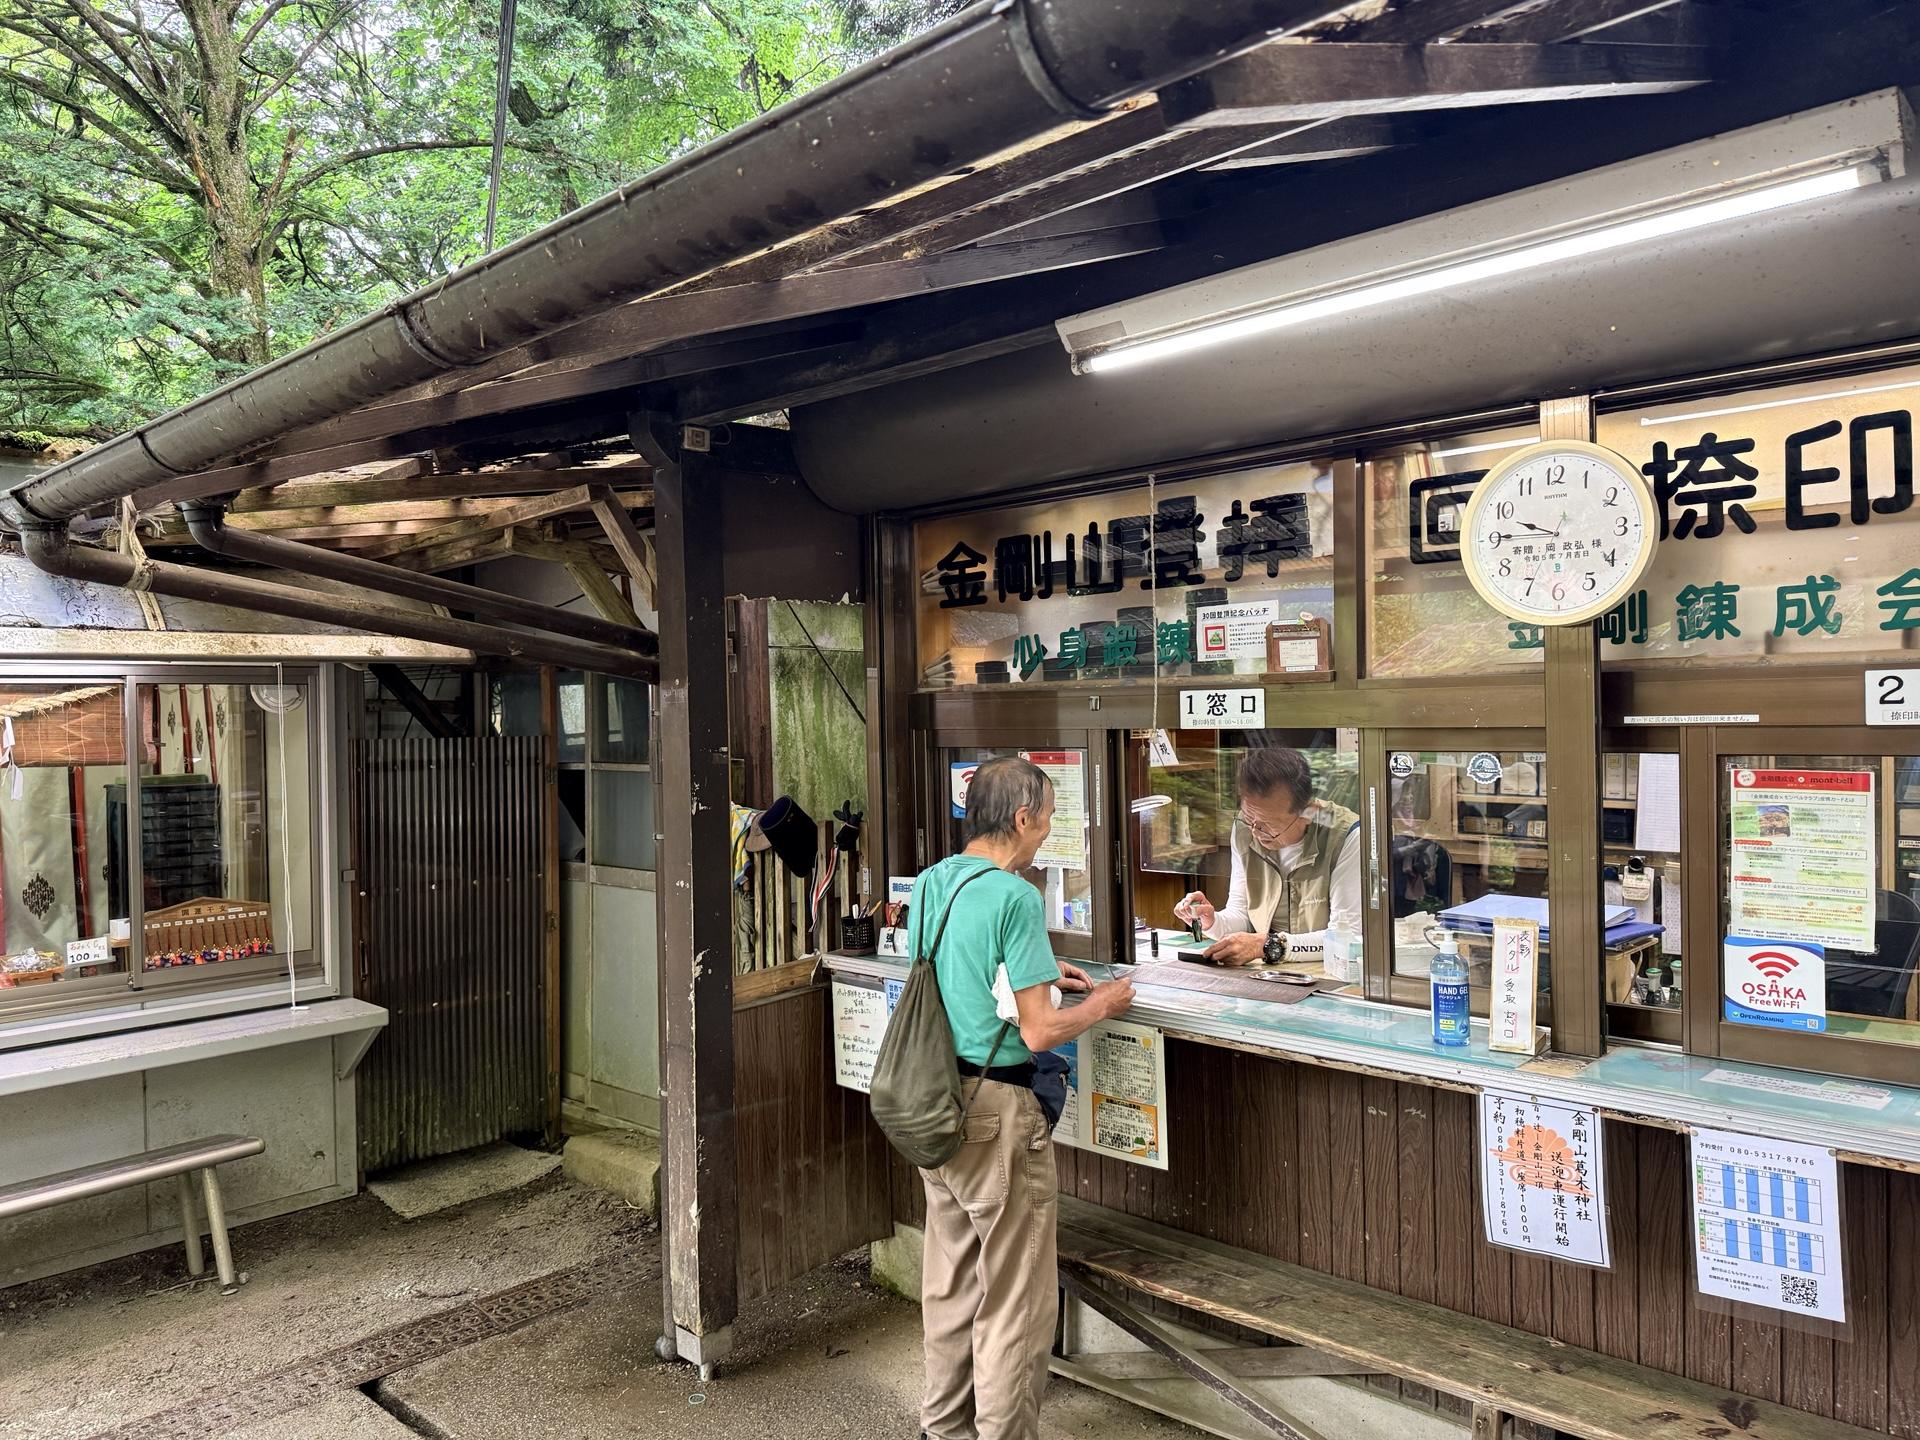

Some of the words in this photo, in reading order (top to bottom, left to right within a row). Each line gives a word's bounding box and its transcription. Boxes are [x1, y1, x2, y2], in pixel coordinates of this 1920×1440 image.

[1545, 464, 1566, 486] 12
[1582, 470, 1589, 489] 1
[1518, 477, 1533, 497] 11
[1544, 492, 1568, 500] RHYTHM
[1602, 487, 1618, 508] 2
[1496, 500, 1514, 520] 10
[1613, 516, 1628, 536] 3
[1489, 531, 1502, 549] 9
[1562, 540, 1585, 550] 政弘
[1591, 538, 1602, 549] 様
[1498, 558, 1512, 577] 8
[1603, 548, 1616, 567] 4
[1523, 577, 1534, 597] 7
[1582, 571, 1596, 591] 5
[1552, 582, 1565, 601] 6
[1013, 620, 1194, 681] 心身鍛錬
[1878, 675, 1905, 705] 2
[69, 952, 90, 963] 100
[1438, 986, 1458, 995] HAND
[1742, 980, 1806, 1001] OSAKA
[1748, 996, 1772, 1006] Free
[1772, 998, 1800, 1009] Wi-Fi
[1699, 1143, 1723, 1152] 予約受付
[1729, 1146, 1815, 1166] 080-5317-8766
[1572, 1111, 1593, 1222] 金剛山葛木神社
[1551, 1151, 1570, 1247] 送迎車運行開始
